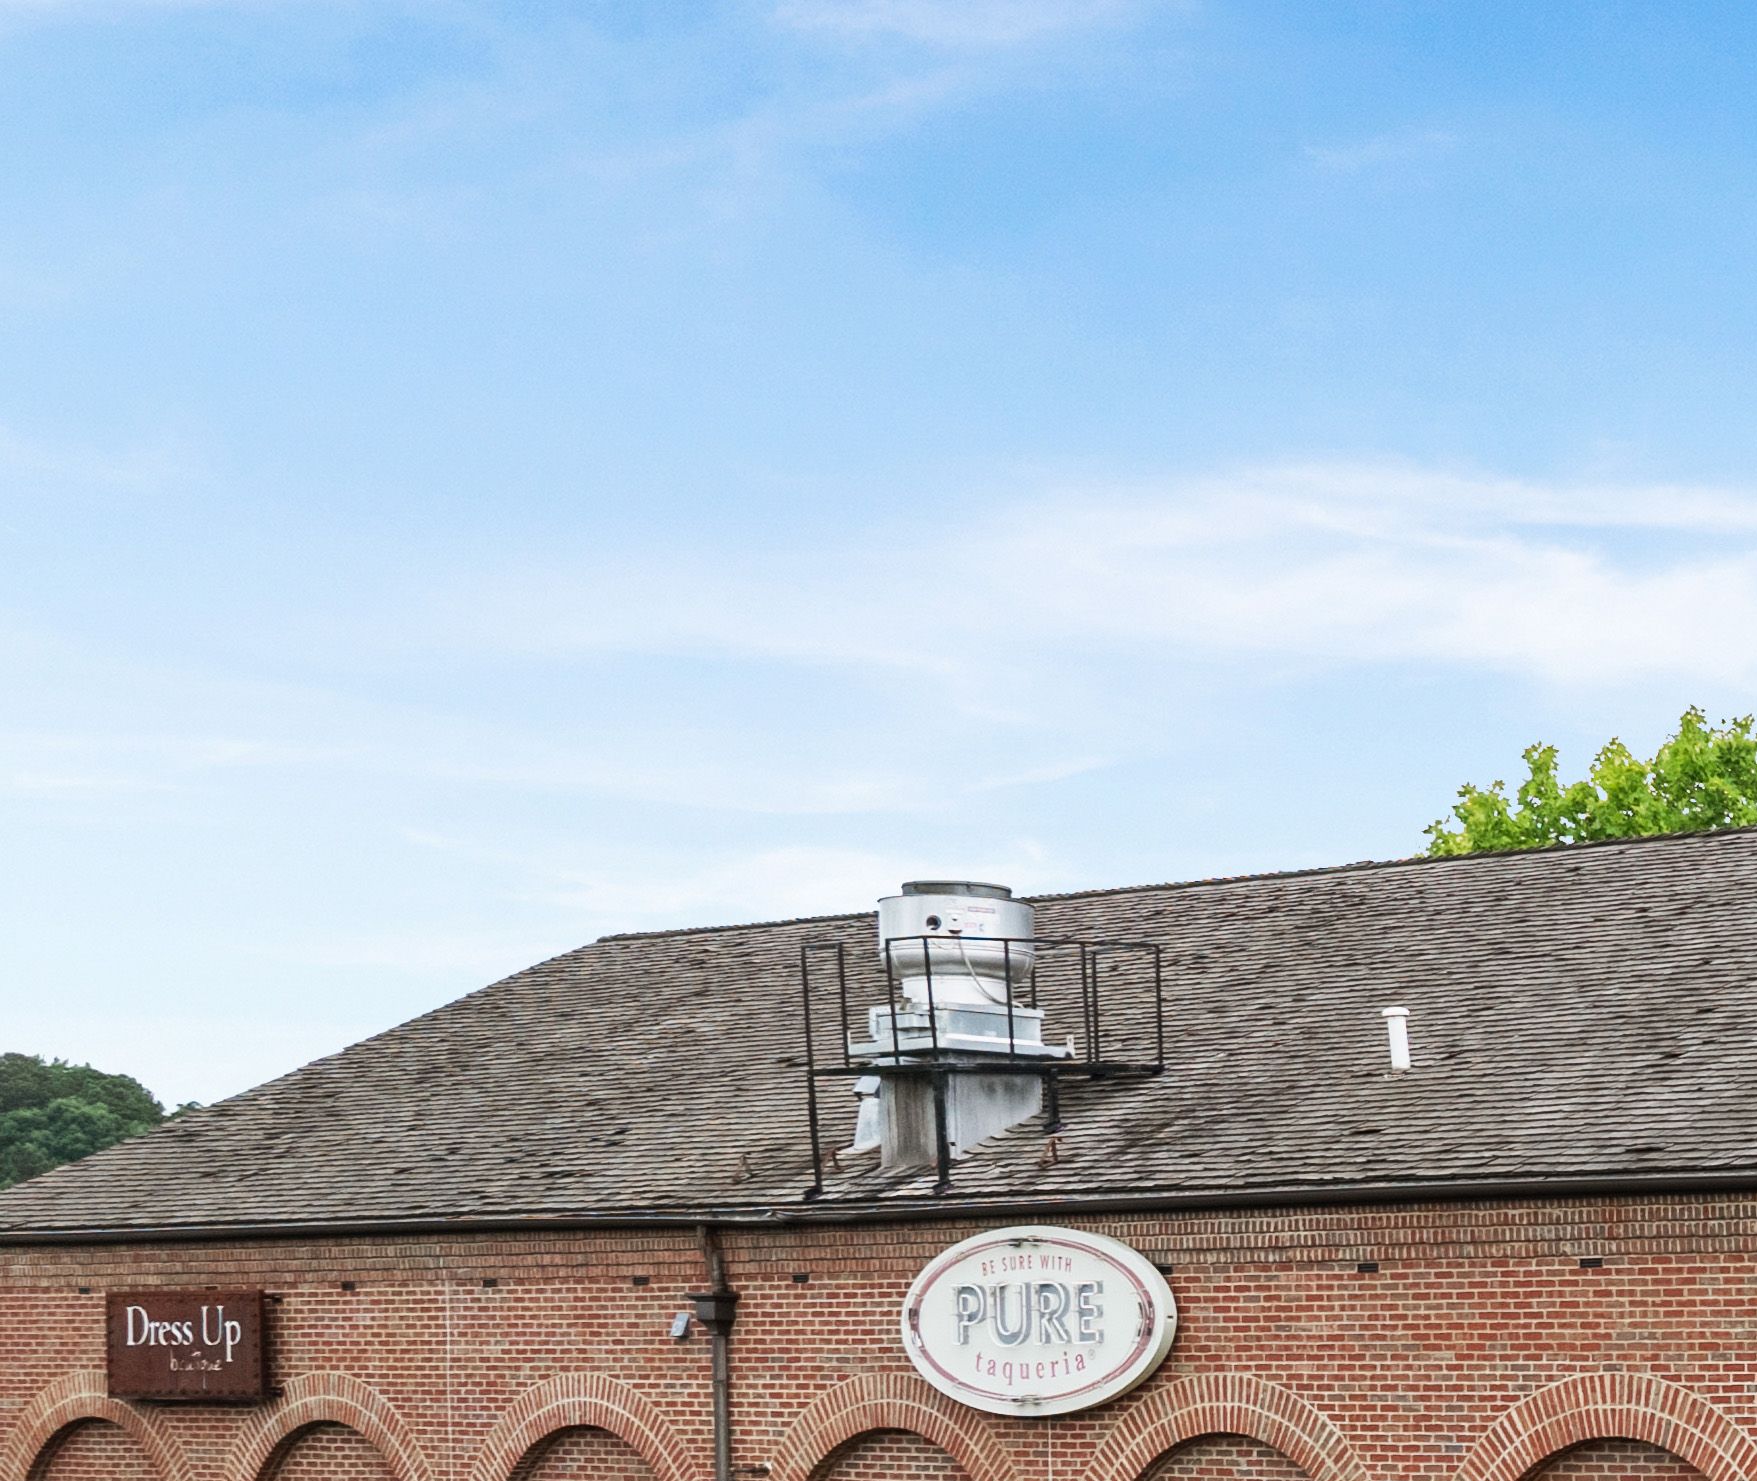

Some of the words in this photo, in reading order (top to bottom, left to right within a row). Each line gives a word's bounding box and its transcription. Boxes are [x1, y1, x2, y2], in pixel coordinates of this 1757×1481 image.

[982, 1260, 995, 1276] BE
[1002, 1255, 1032, 1272] SURE
[1040, 1254, 1072, 1273] WITH
[126, 1305, 194, 1346] Dress
[201, 1305, 242, 1363] Up
[951, 1280, 1104, 1348] PURE
